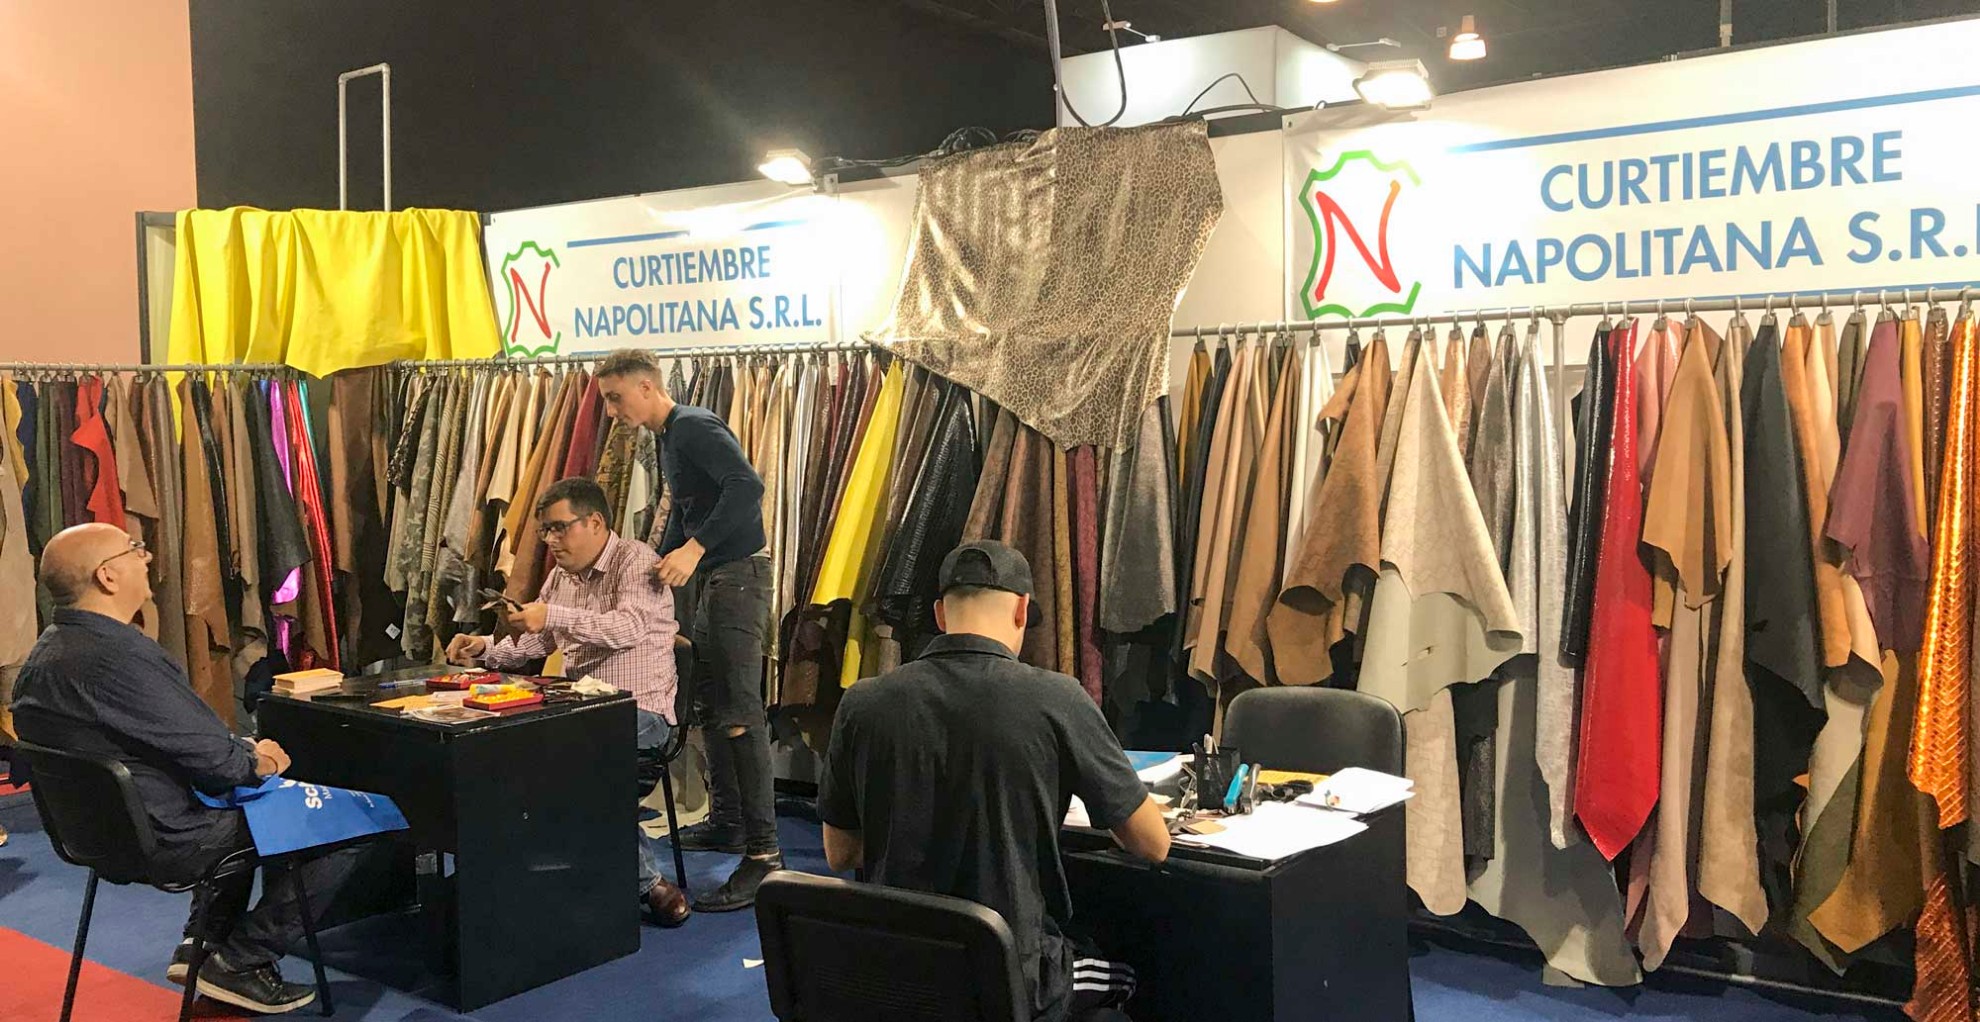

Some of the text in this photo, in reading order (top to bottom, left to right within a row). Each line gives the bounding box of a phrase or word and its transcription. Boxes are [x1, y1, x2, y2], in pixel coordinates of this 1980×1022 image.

[1541, 130, 1903, 212] CURTIEMBRE
[613, 245, 771, 289] CURTIEMBRE
[1316, 180, 1401, 301] N
[1453, 203, 1980, 289] NAPOLITANA S.R.
[510, 261, 551, 343] N
[574, 294, 822, 337] NAPOLITANA S.R.L.
